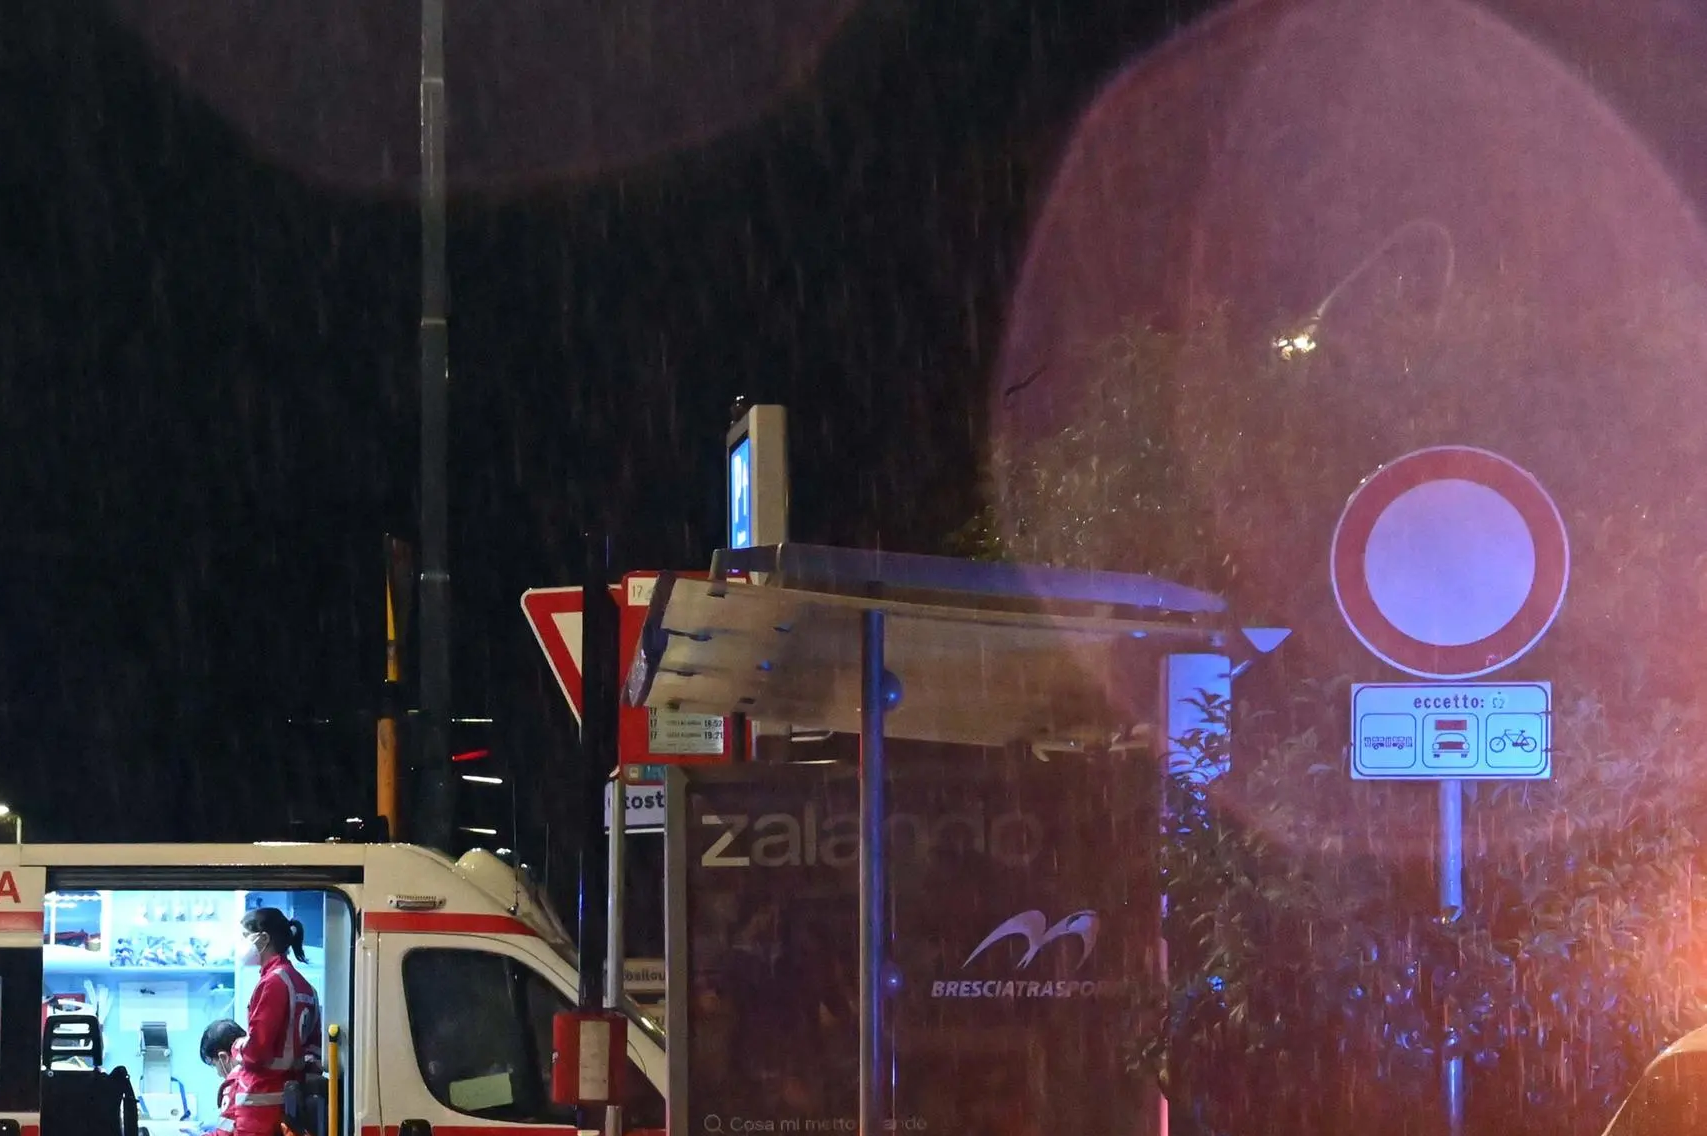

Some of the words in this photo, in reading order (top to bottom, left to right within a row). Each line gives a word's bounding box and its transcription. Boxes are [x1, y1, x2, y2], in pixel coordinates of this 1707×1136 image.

[1413, 694, 1485, 709] eccetto:
[930, 980, 1123, 999] BRESCIATRASPO
[729, 1116, 775, 1132] Cosa
